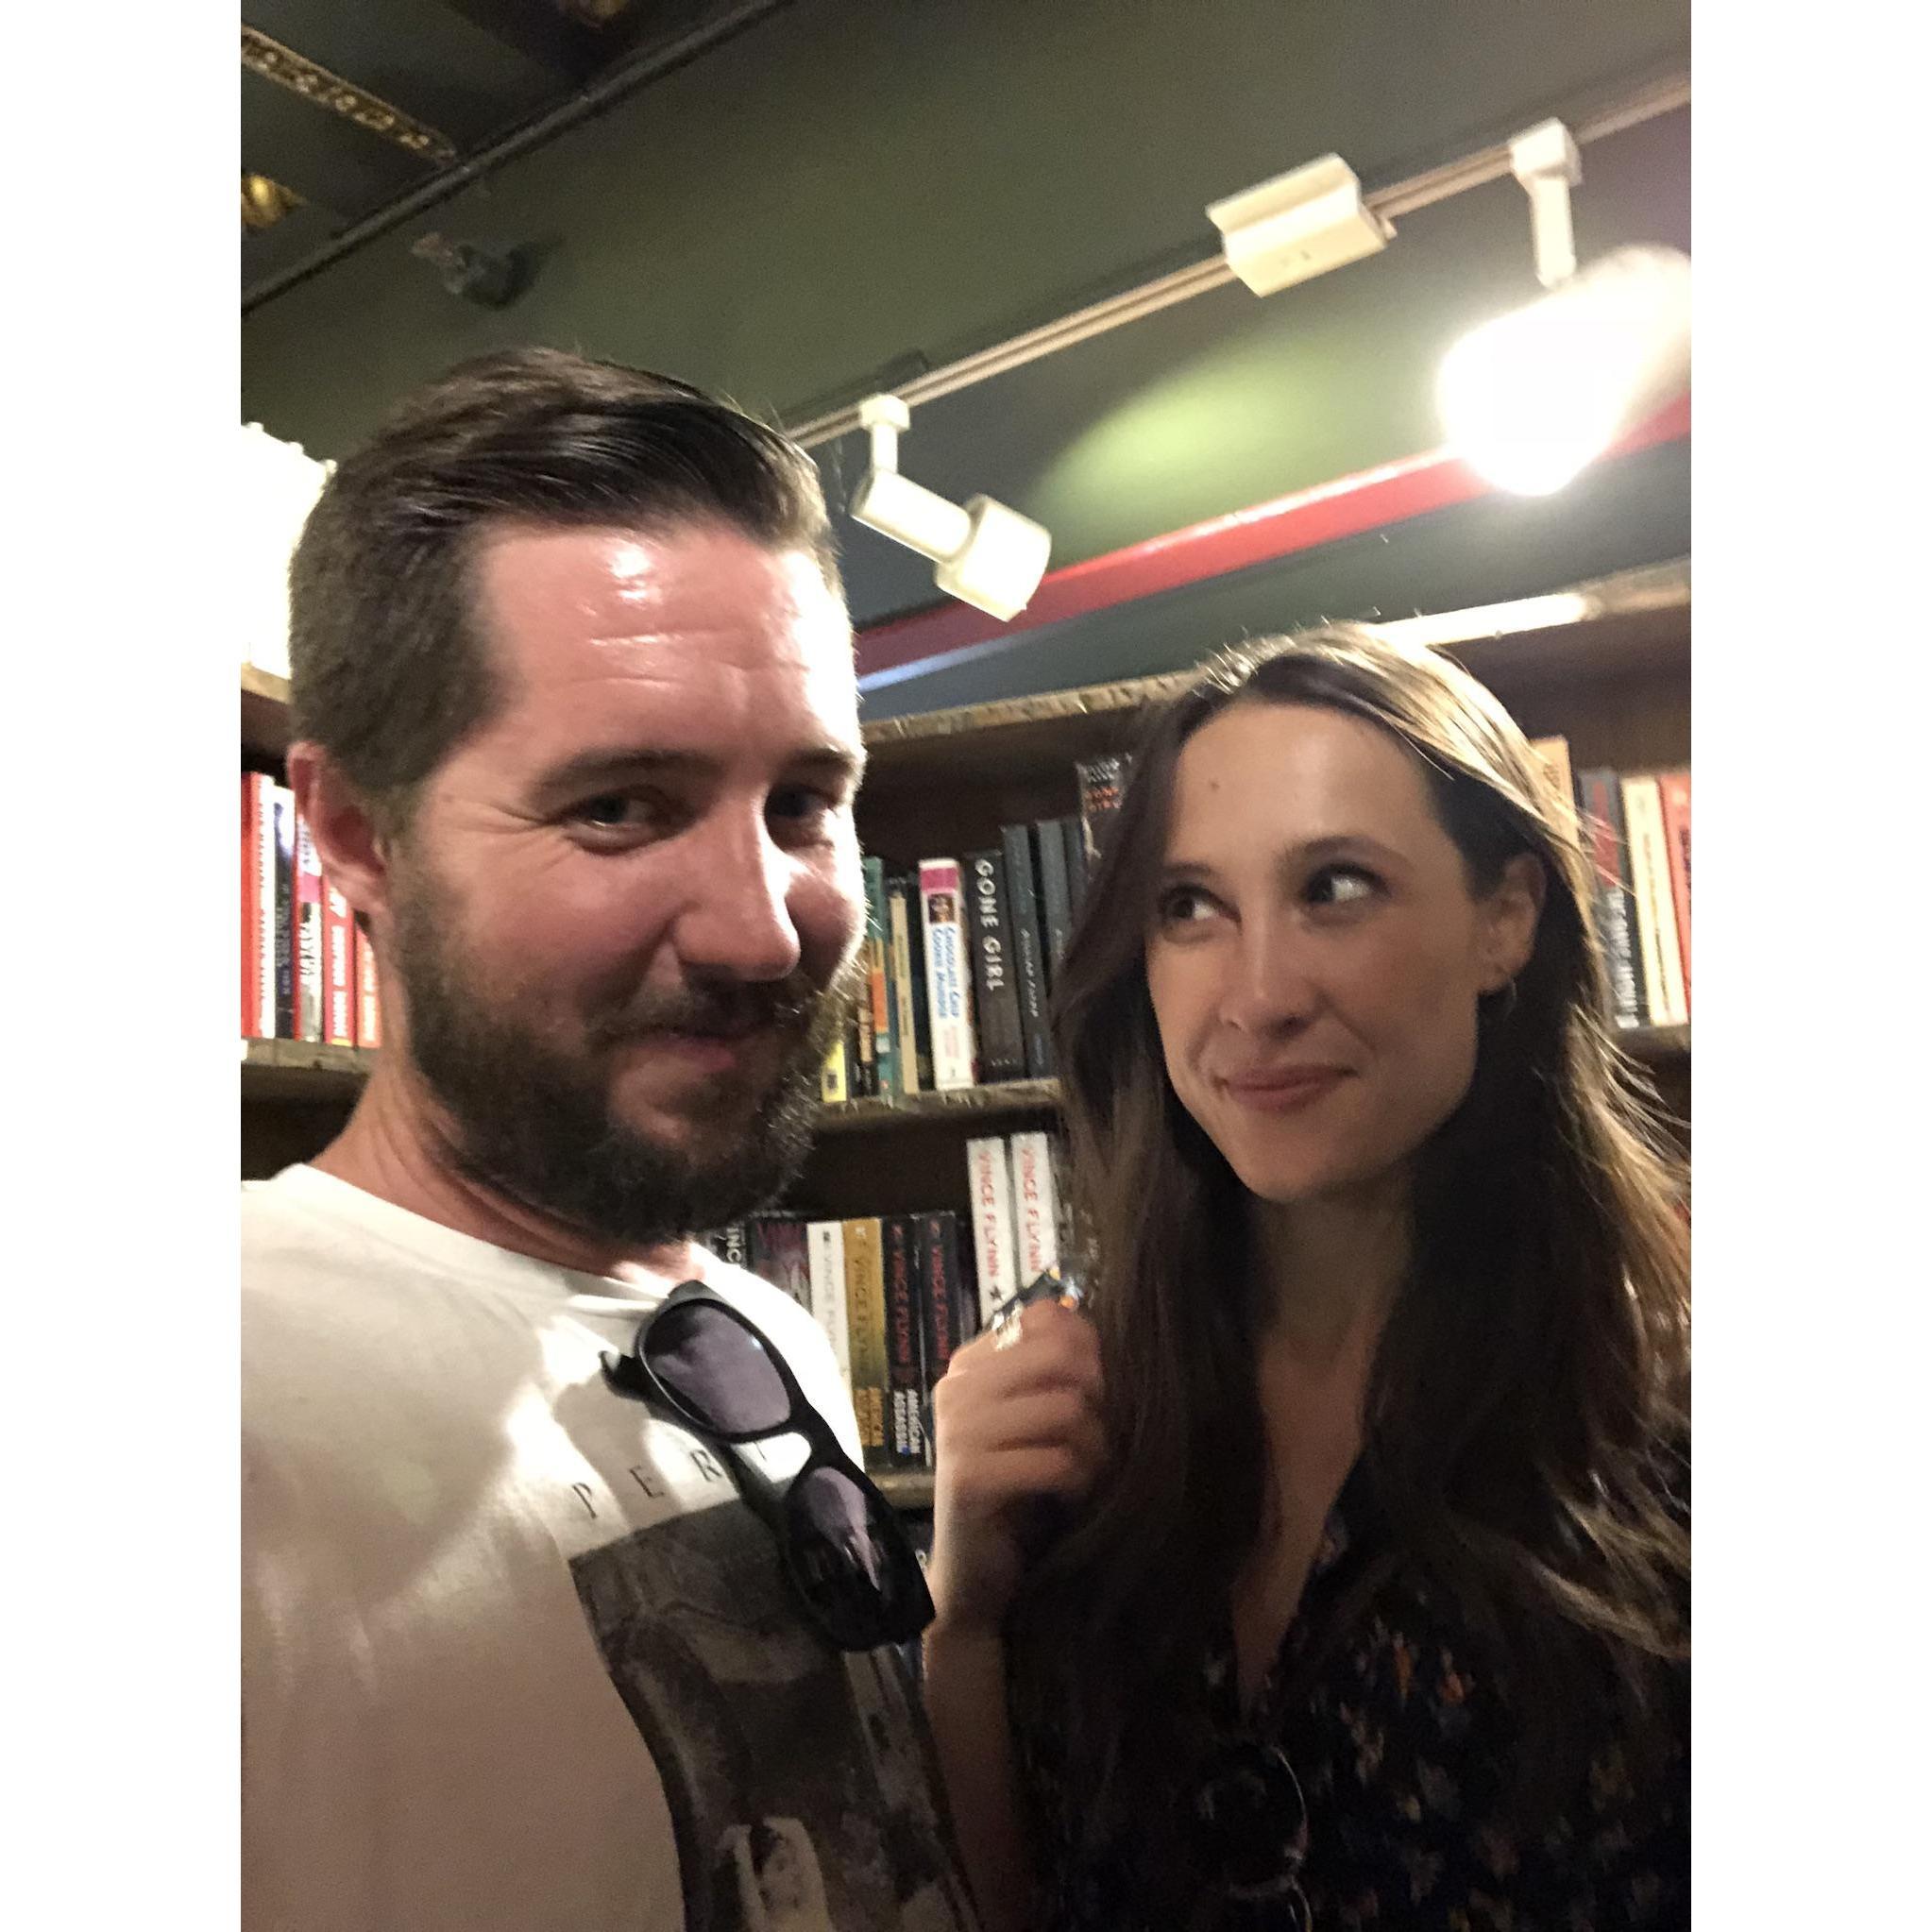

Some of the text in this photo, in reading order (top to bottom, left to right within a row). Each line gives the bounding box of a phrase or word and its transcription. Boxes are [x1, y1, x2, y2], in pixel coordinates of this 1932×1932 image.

[974, 858, 1005, 991] GONE GIRL
[725, 1227, 742, 1263] INC
[979, 1151, 999, 1277] VINCE FLYNN
[1022, 1147, 1042, 1273] VINCE FLYNN
